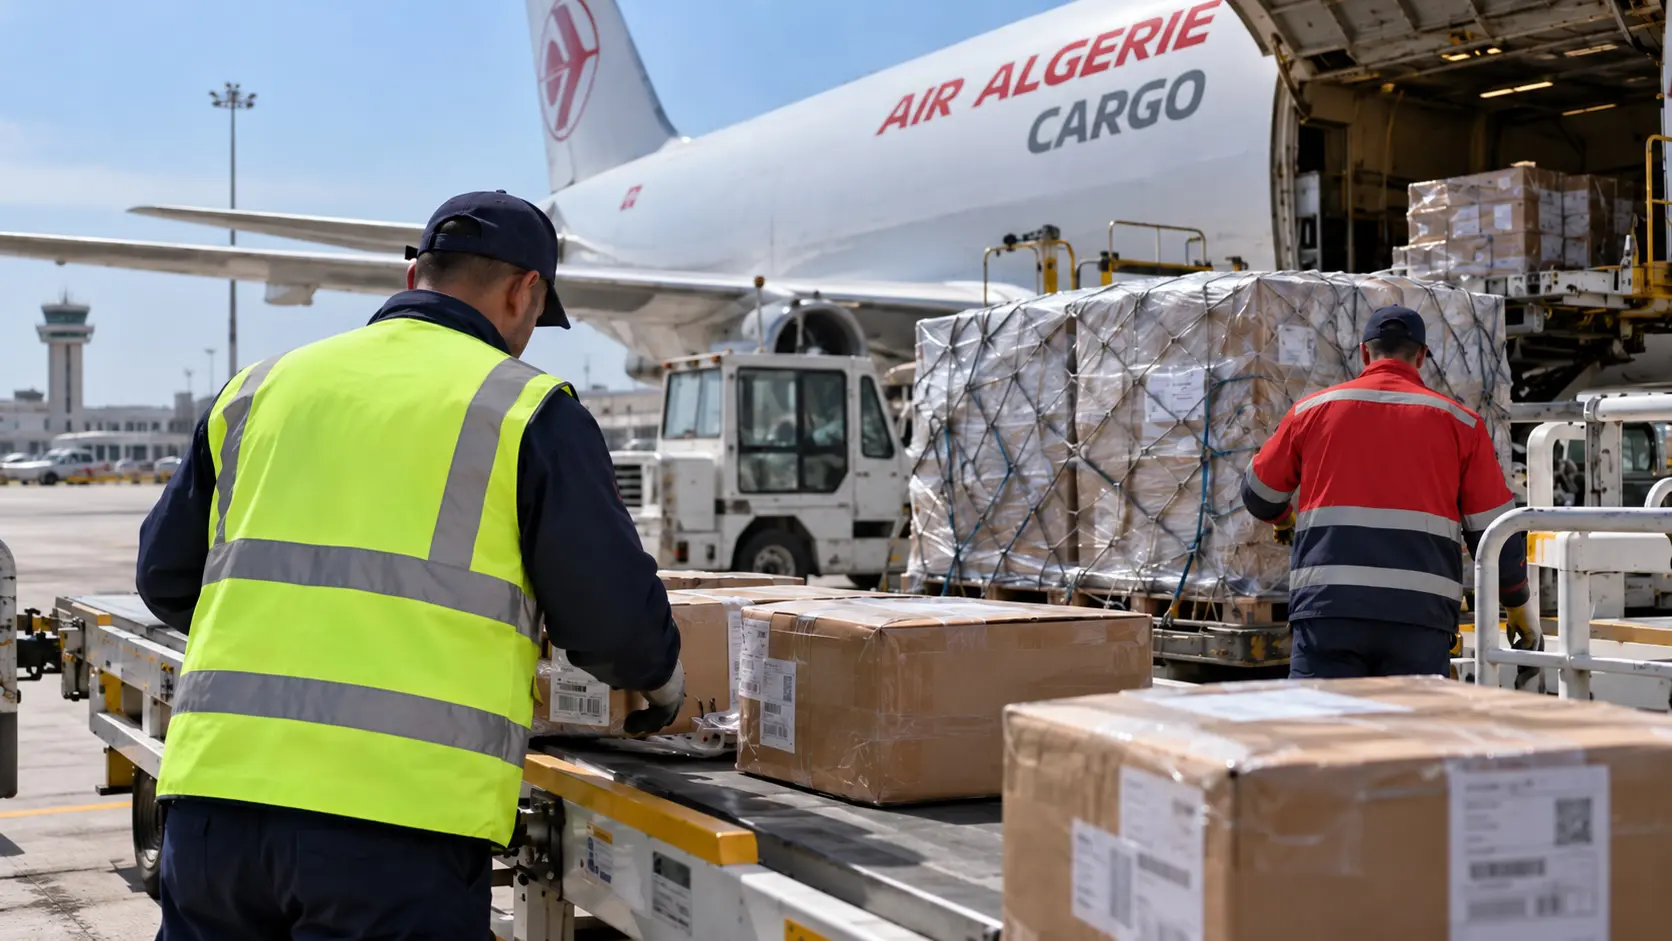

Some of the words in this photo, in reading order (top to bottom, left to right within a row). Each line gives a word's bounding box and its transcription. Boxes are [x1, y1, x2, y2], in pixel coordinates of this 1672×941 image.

[876, 78, 965, 135] AIR
[972, 0, 1223, 108] ALGERIE
[1027, 69, 1206, 154] CARGO
